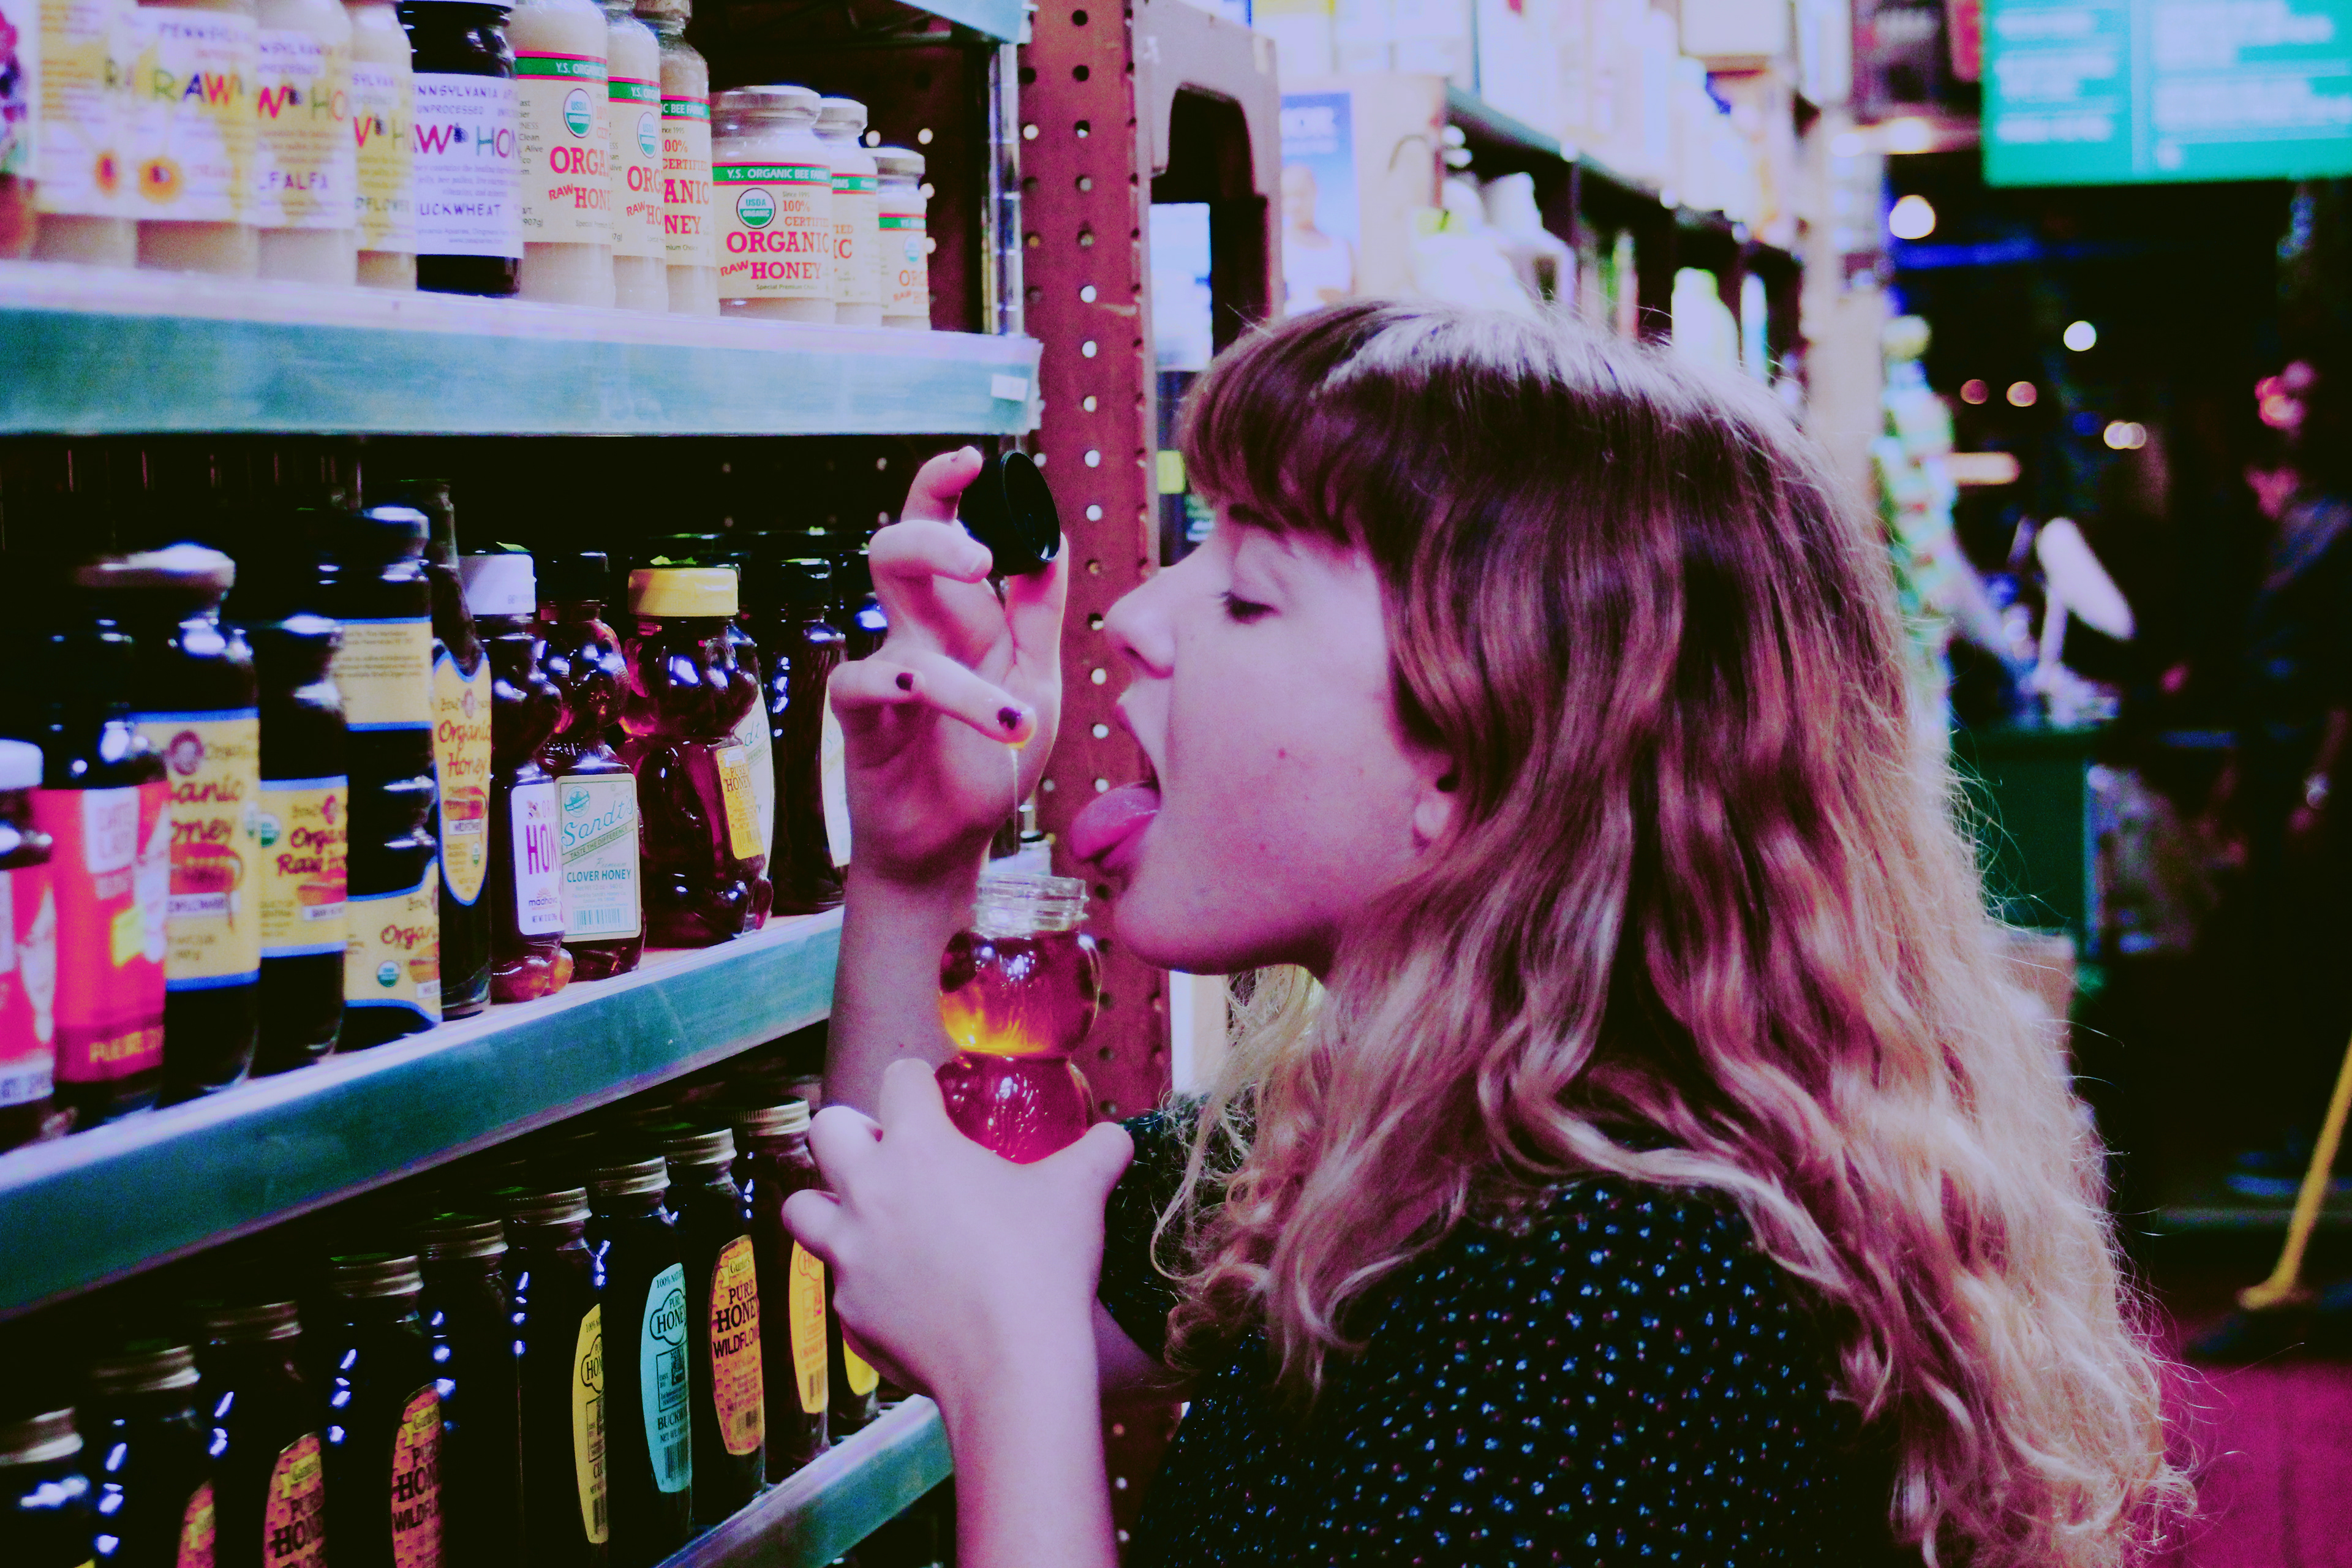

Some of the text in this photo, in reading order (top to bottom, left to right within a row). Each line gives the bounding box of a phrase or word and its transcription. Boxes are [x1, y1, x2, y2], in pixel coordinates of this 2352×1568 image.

[152, 67, 244, 107] RAW
[570, 100, 587, 111] USDA
[670, 104, 685, 115] BEE
[413, 124, 453, 155] W
[526, 144, 544, 153] Alive
[549, 145, 611, 178] ORGA
[726, 168, 744, 179] Y.S.
[747, 168, 793, 179] ORGANIC
[794, 169, 809, 179] BEE
[548, 183, 574, 201] RAW
[626, 200, 646, 217] RAW
[783, 200, 810, 213] 100%
[726, 231, 830, 254] ORGANIC
[720, 260, 821, 280] RAW HONEY
[439, 719, 491, 752] Organic
[448, 752, 488, 782] Honey
[730, 765, 747, 777] PURE
[725, 775, 751, 793] HONEY
[560, 797, 633, 850] Sandt's
[570, 824, 628, 859] TASTE THE DIFFERENCE
[566, 869, 632, 883] CLOVER HONEY
[656, 1275, 670, 1289] 100%
[729, 1278, 754, 1305] PURE
[396, 1466, 428, 1502] HO
[274, 1519, 306, 1558] HO
